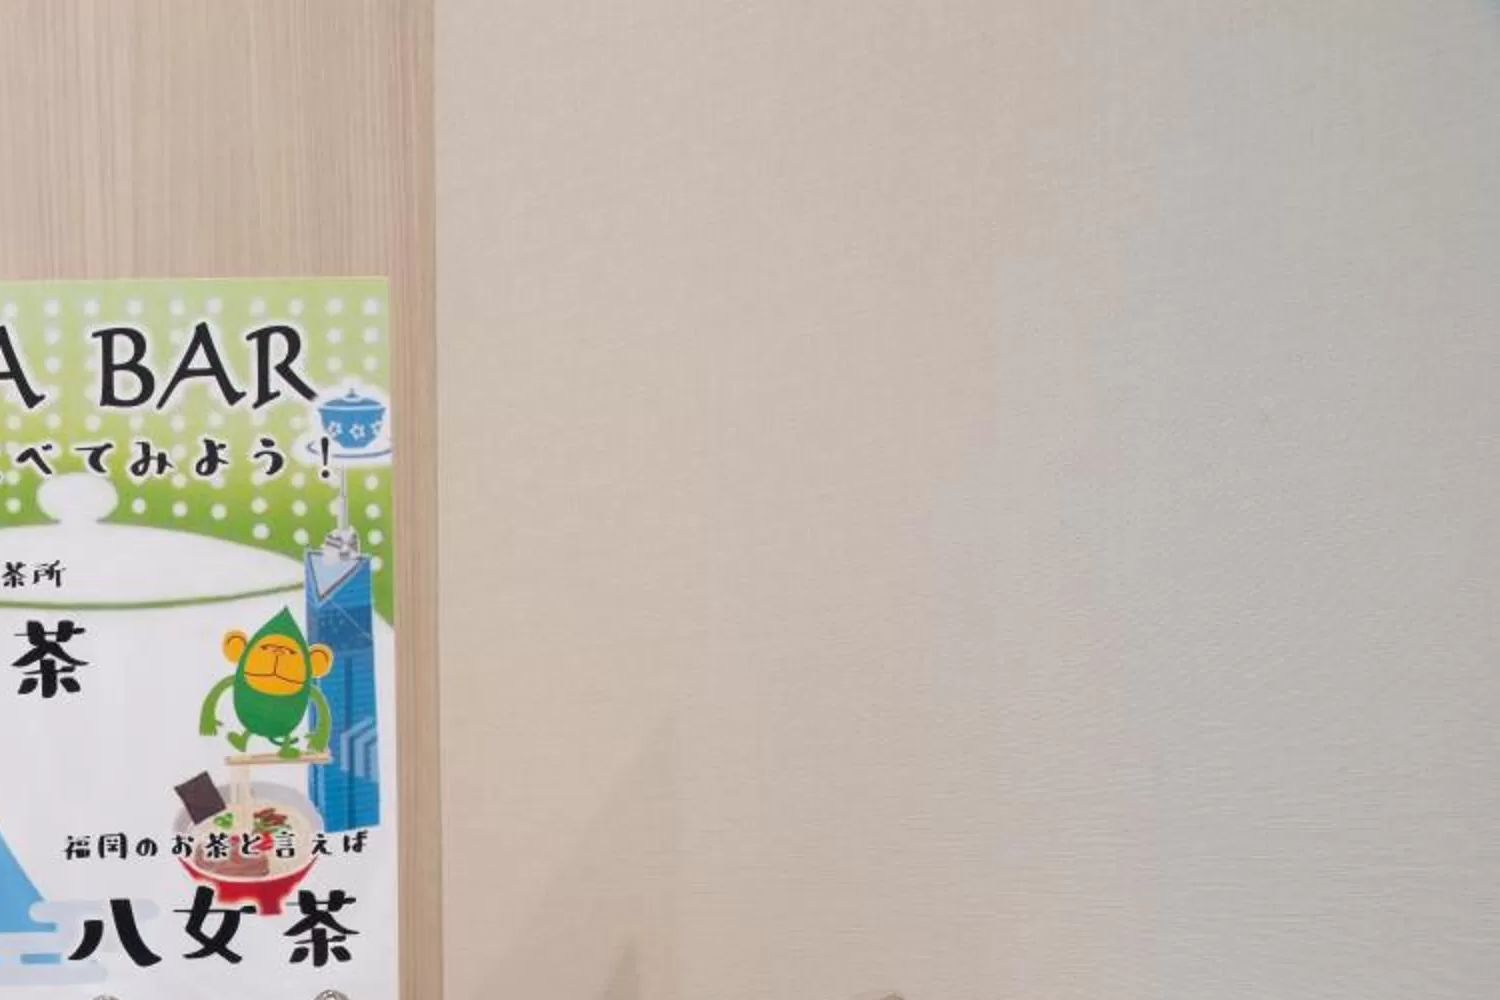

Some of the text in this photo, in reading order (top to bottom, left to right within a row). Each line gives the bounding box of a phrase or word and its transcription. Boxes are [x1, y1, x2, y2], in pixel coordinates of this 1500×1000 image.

[92, 321, 319, 410] BAR
[62, 830, 369, 861] 福岡のお茶と言えば
[68, 885, 361, 968] 八女茶
